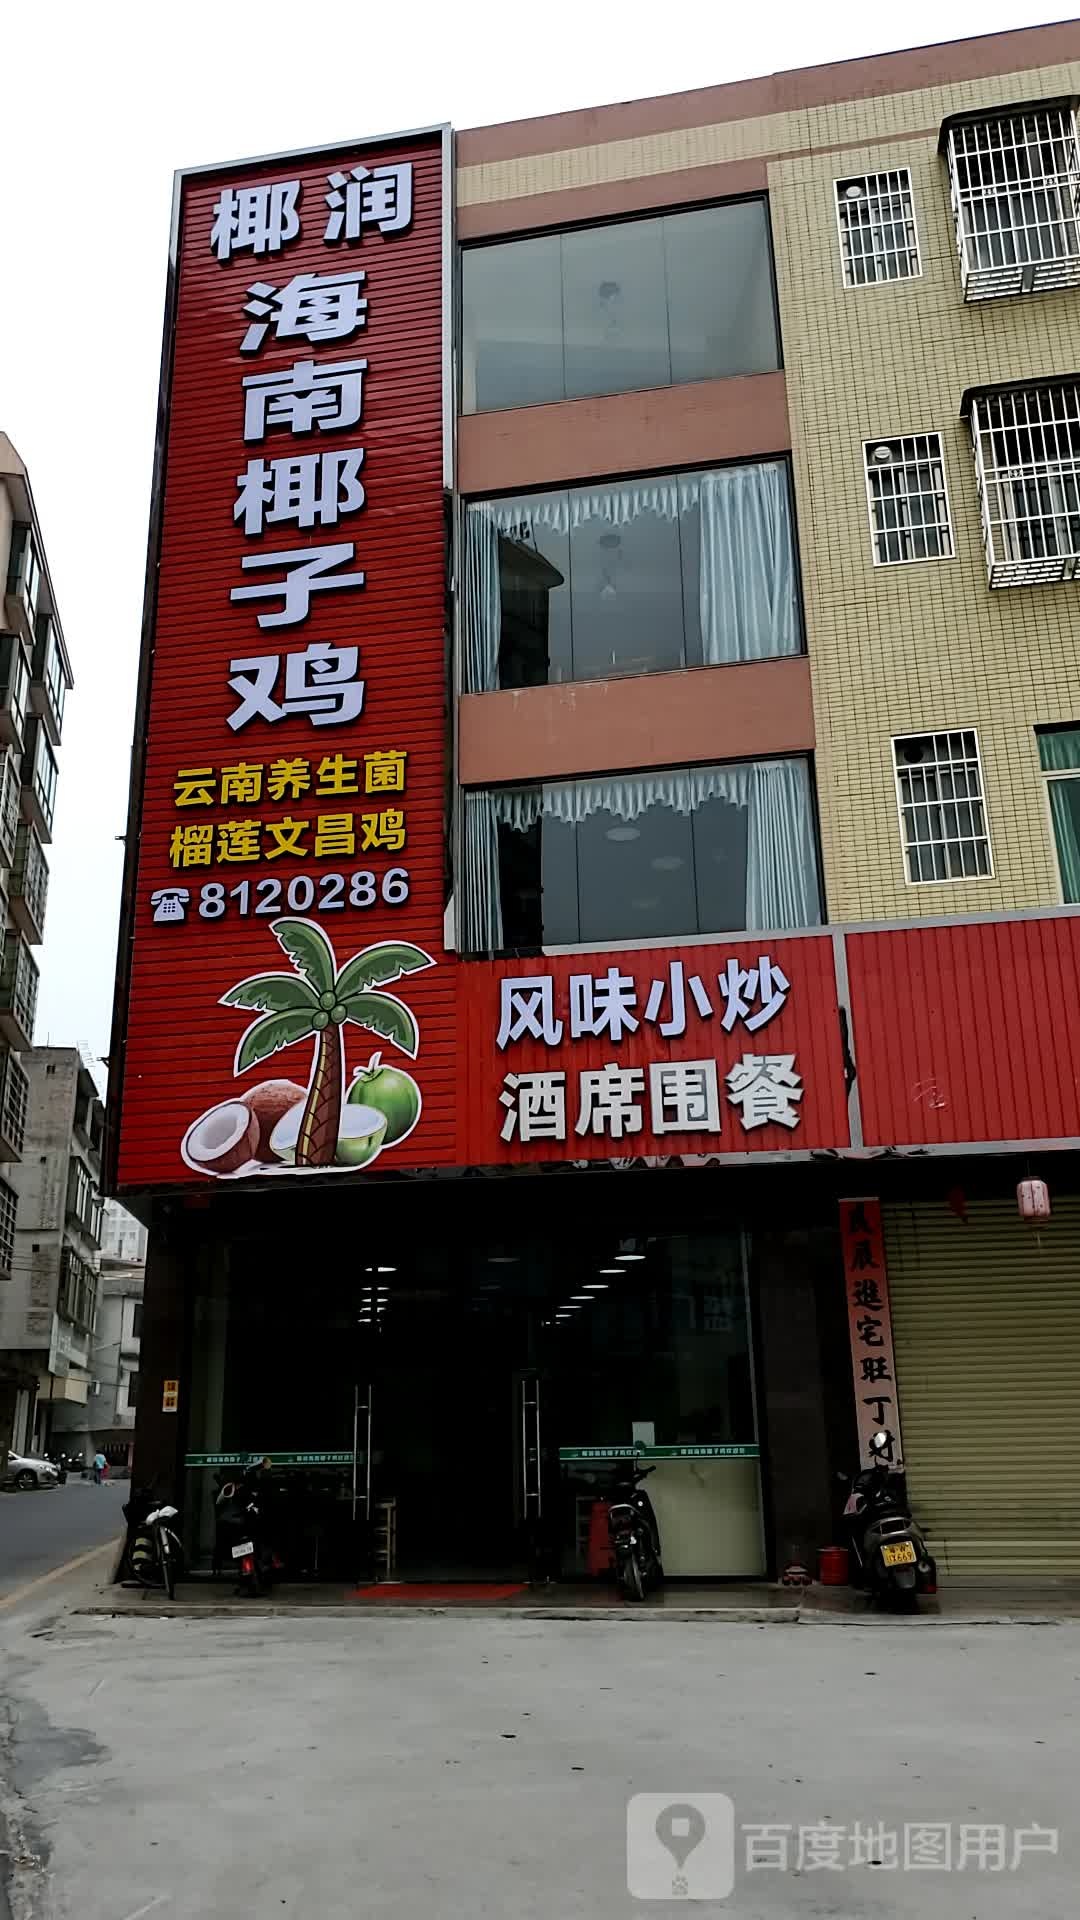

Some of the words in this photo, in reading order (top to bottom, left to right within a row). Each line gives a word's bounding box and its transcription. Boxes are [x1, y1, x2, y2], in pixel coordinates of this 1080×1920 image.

[226, 270, 368, 732] 海南椰子鸡
[173, 749, 408, 807] 云南养生菌
[169, 808, 406, 868] 榴莲文昌鸡
[198, 867, 410, 919] 8120286
[496, 955, 791, 1051] 风味小炒
[499, 1053, 804, 1143] 酒席围餐
